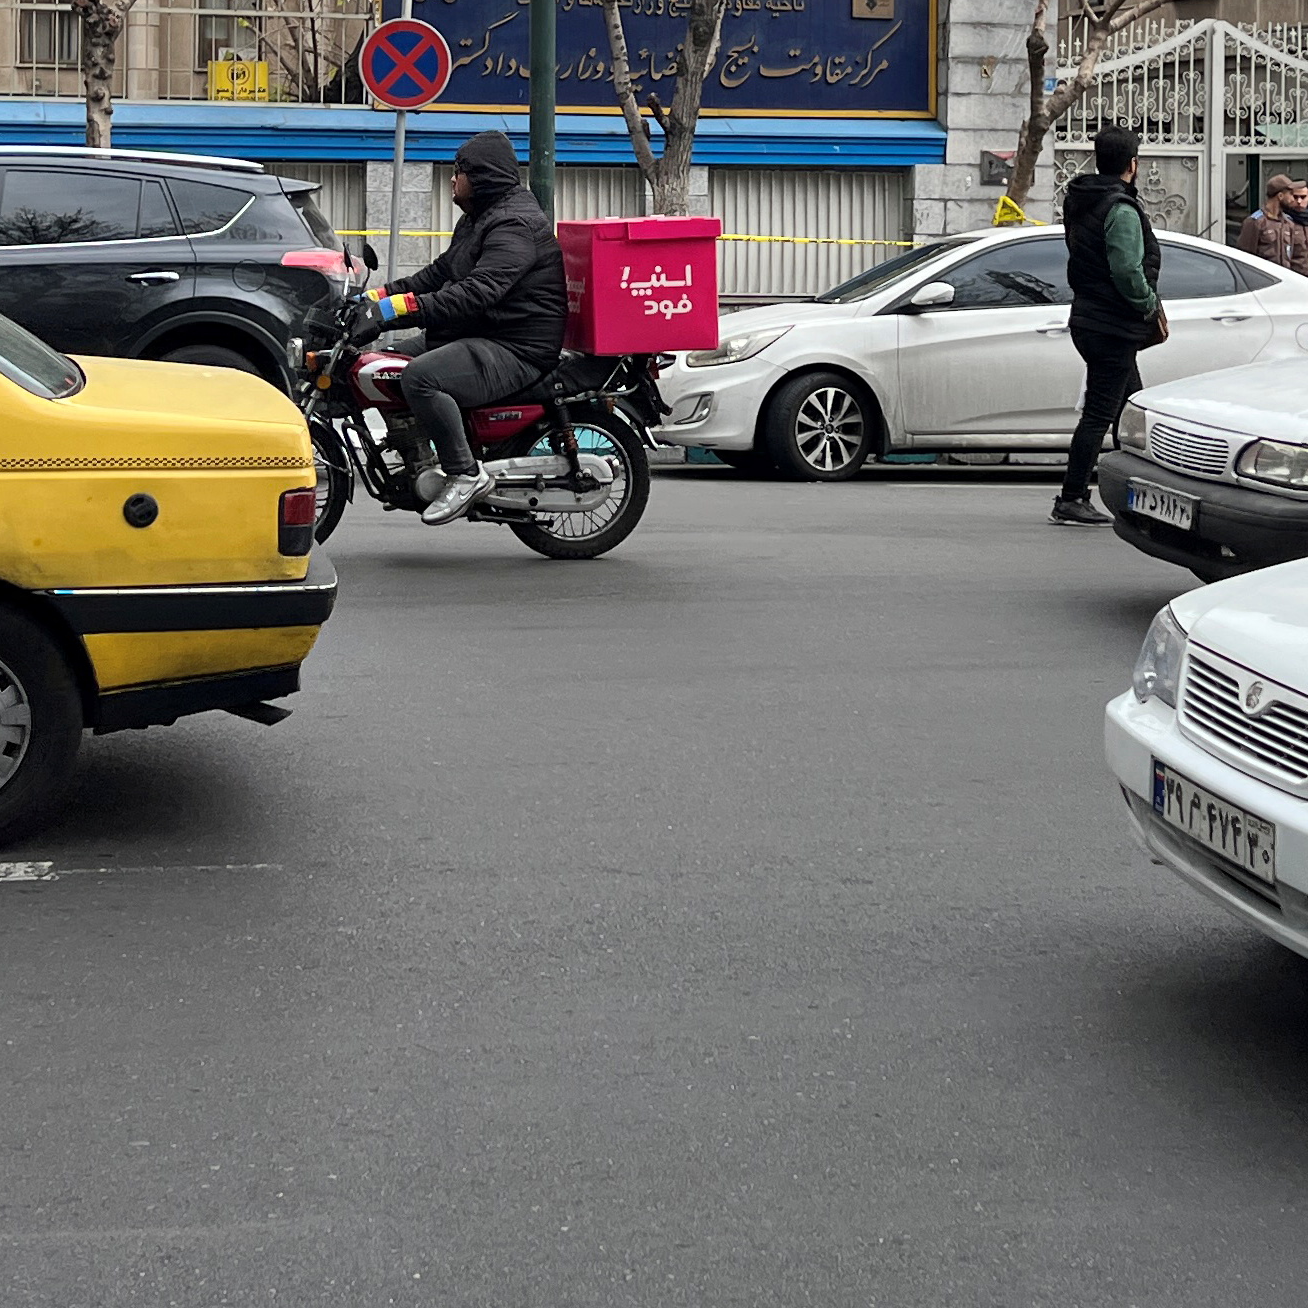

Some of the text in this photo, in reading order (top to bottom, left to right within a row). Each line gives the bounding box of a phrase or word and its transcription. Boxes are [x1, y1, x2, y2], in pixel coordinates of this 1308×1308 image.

[719, 34, 759, 88] بسیج
[758, 47, 852, 85] مقاومت
[850, 19, 904, 88] مرکز
[619, 264, 693, 297] اسنپ!
[643, 294, 693, 320] فود
